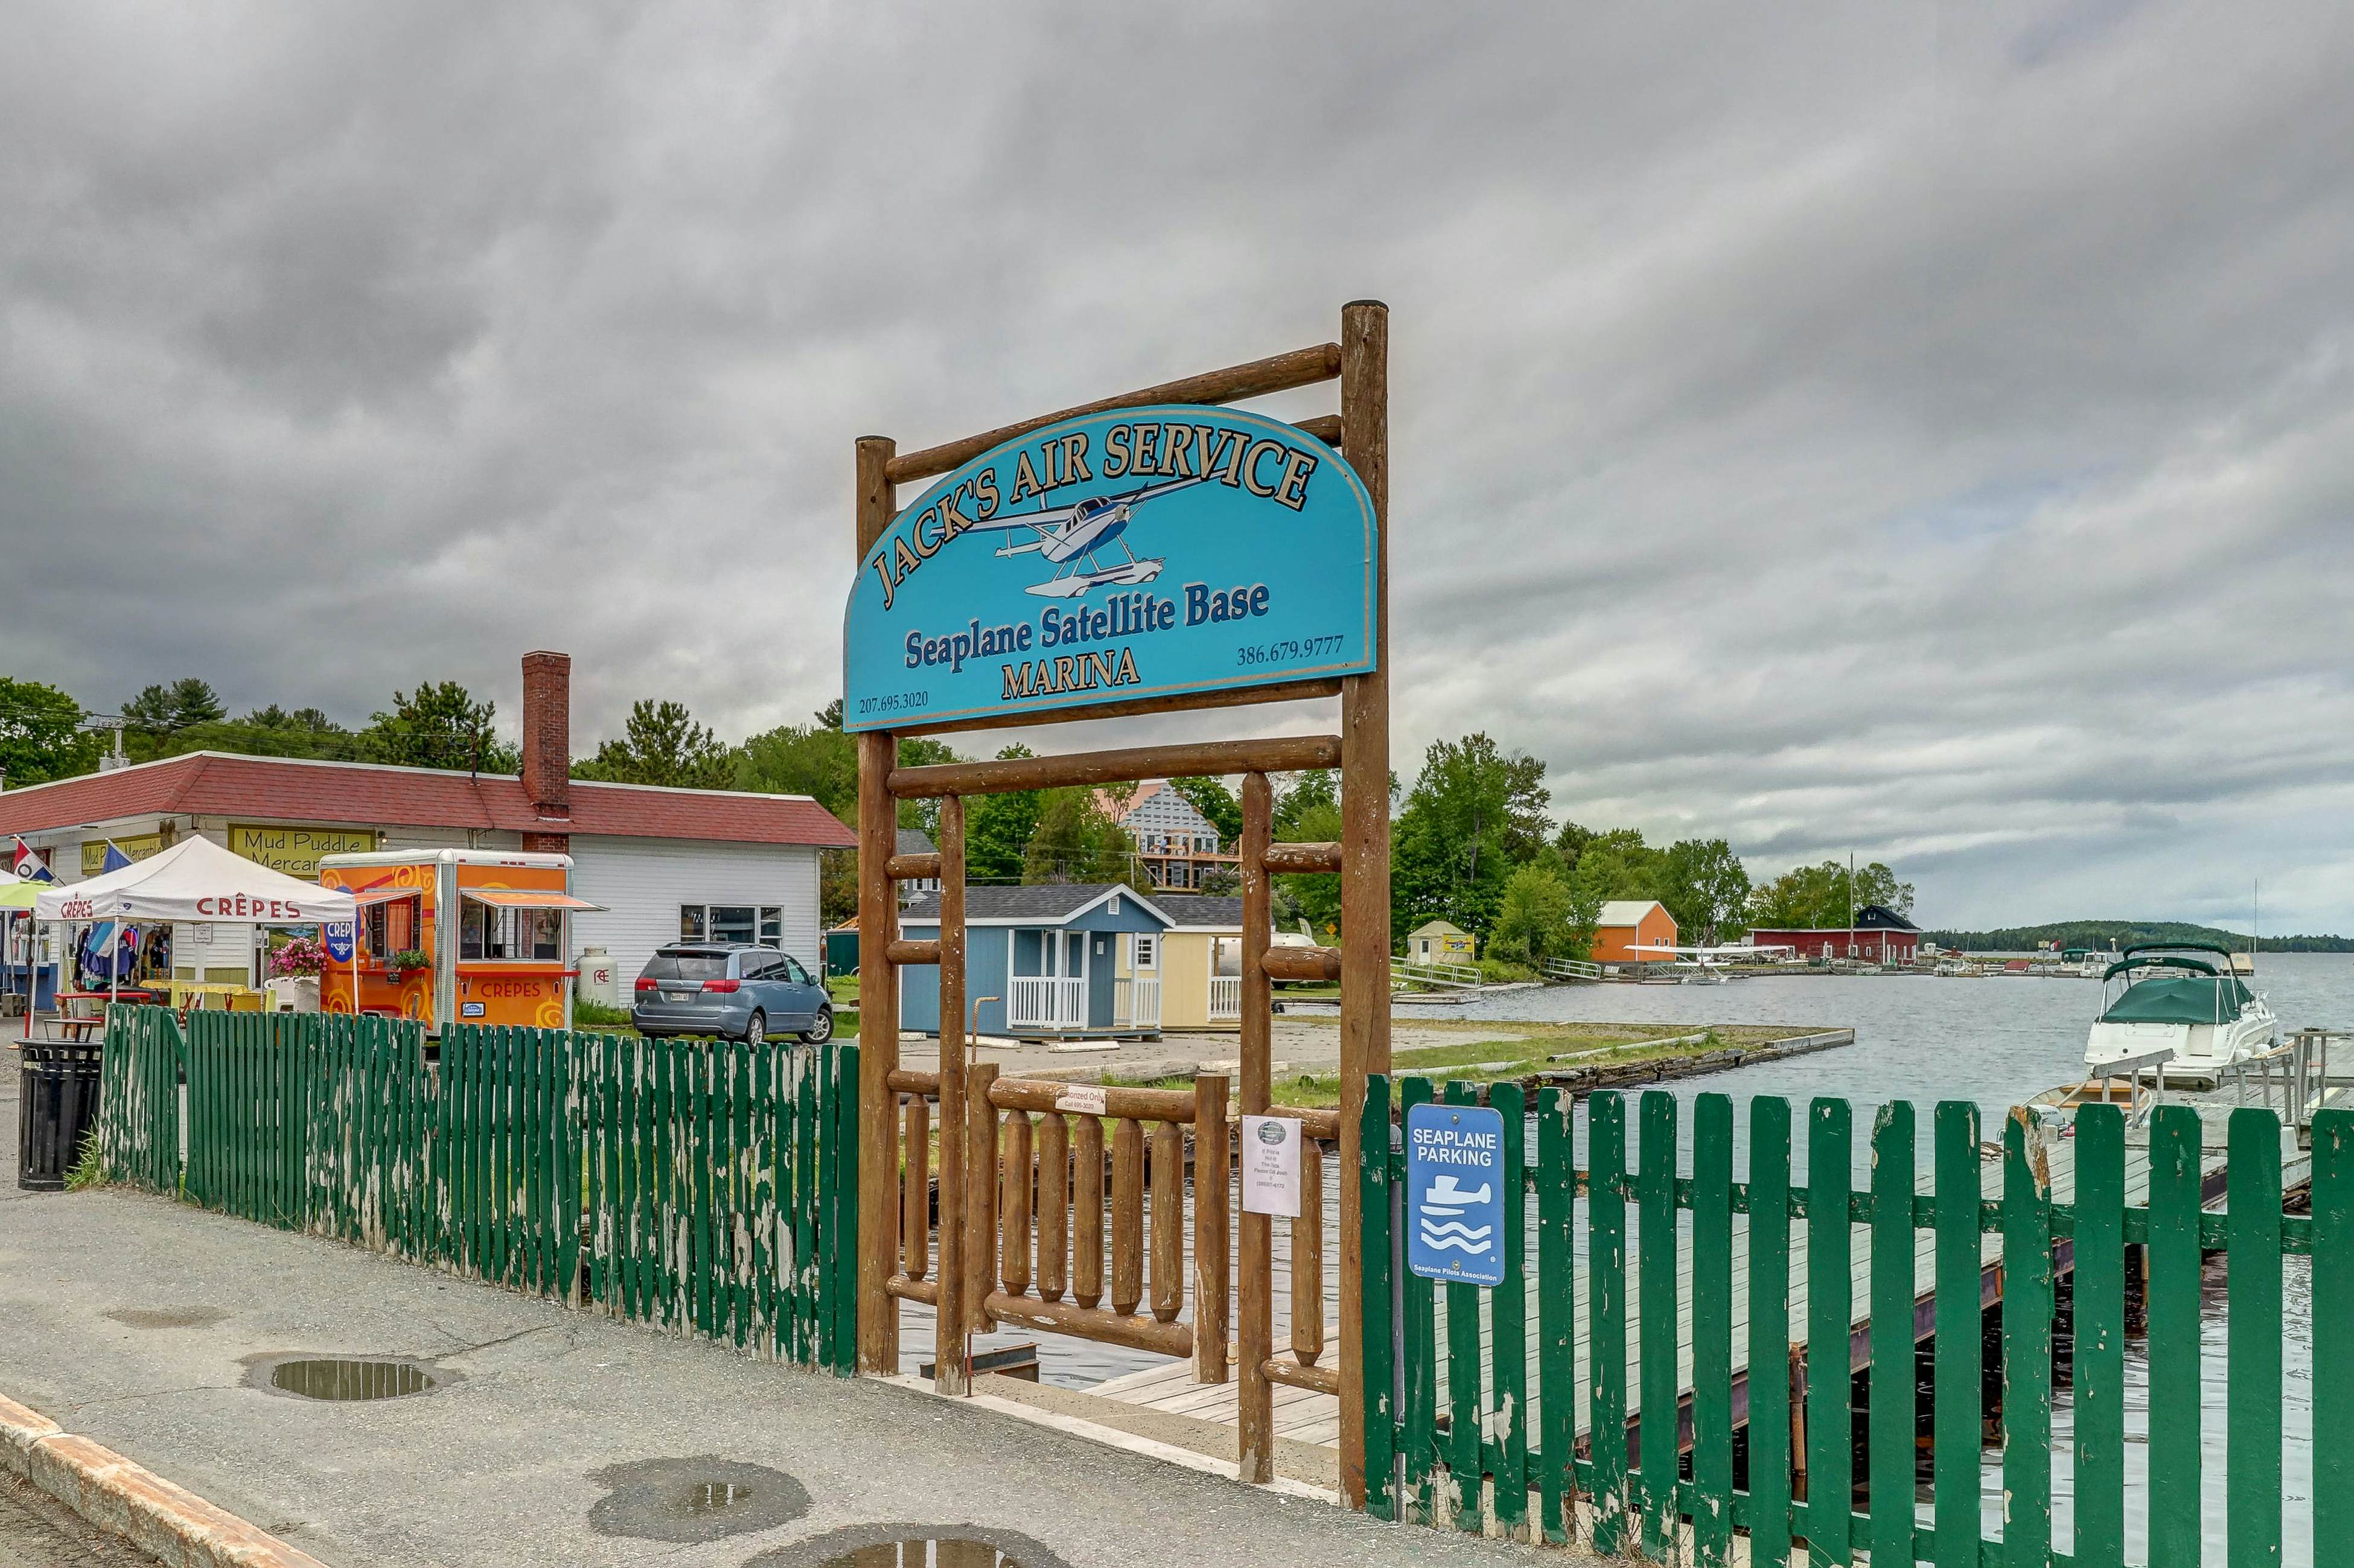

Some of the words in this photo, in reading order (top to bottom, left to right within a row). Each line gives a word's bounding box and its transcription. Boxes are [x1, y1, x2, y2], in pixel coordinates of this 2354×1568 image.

[873, 467, 1000, 611] JACK'S
[1010, 432, 1093, 505] AIR
[1103, 422, 1318, 512] SERVICE
[905, 618, 1033, 673] Seaplane
[1041, 591, 1176, 648] Satellite
[1182, 582, 1270, 627] Base
[1237, 634, 1344, 666] 386.679.9777
[1001, 646, 1141, 700] MARINA
[859, 690, 928, 714] 207.695.3020
[245, 829, 285, 853] Mud
[294, 832, 360, 853] Puddle
[85, 847, 98, 868] Mud
[197, 891, 301, 919] CRÊPES
[480, 979, 541, 998] CRÊPES
[1412, 1128, 1497, 1149] SEAPLANE
[1418, 1146, 1492, 1167] PARKING
[1414, 1264, 1441, 1274] Seaplane
[1442, 1267, 1460, 1276] Pilots
[1461, 1270, 1498, 1281] Association
